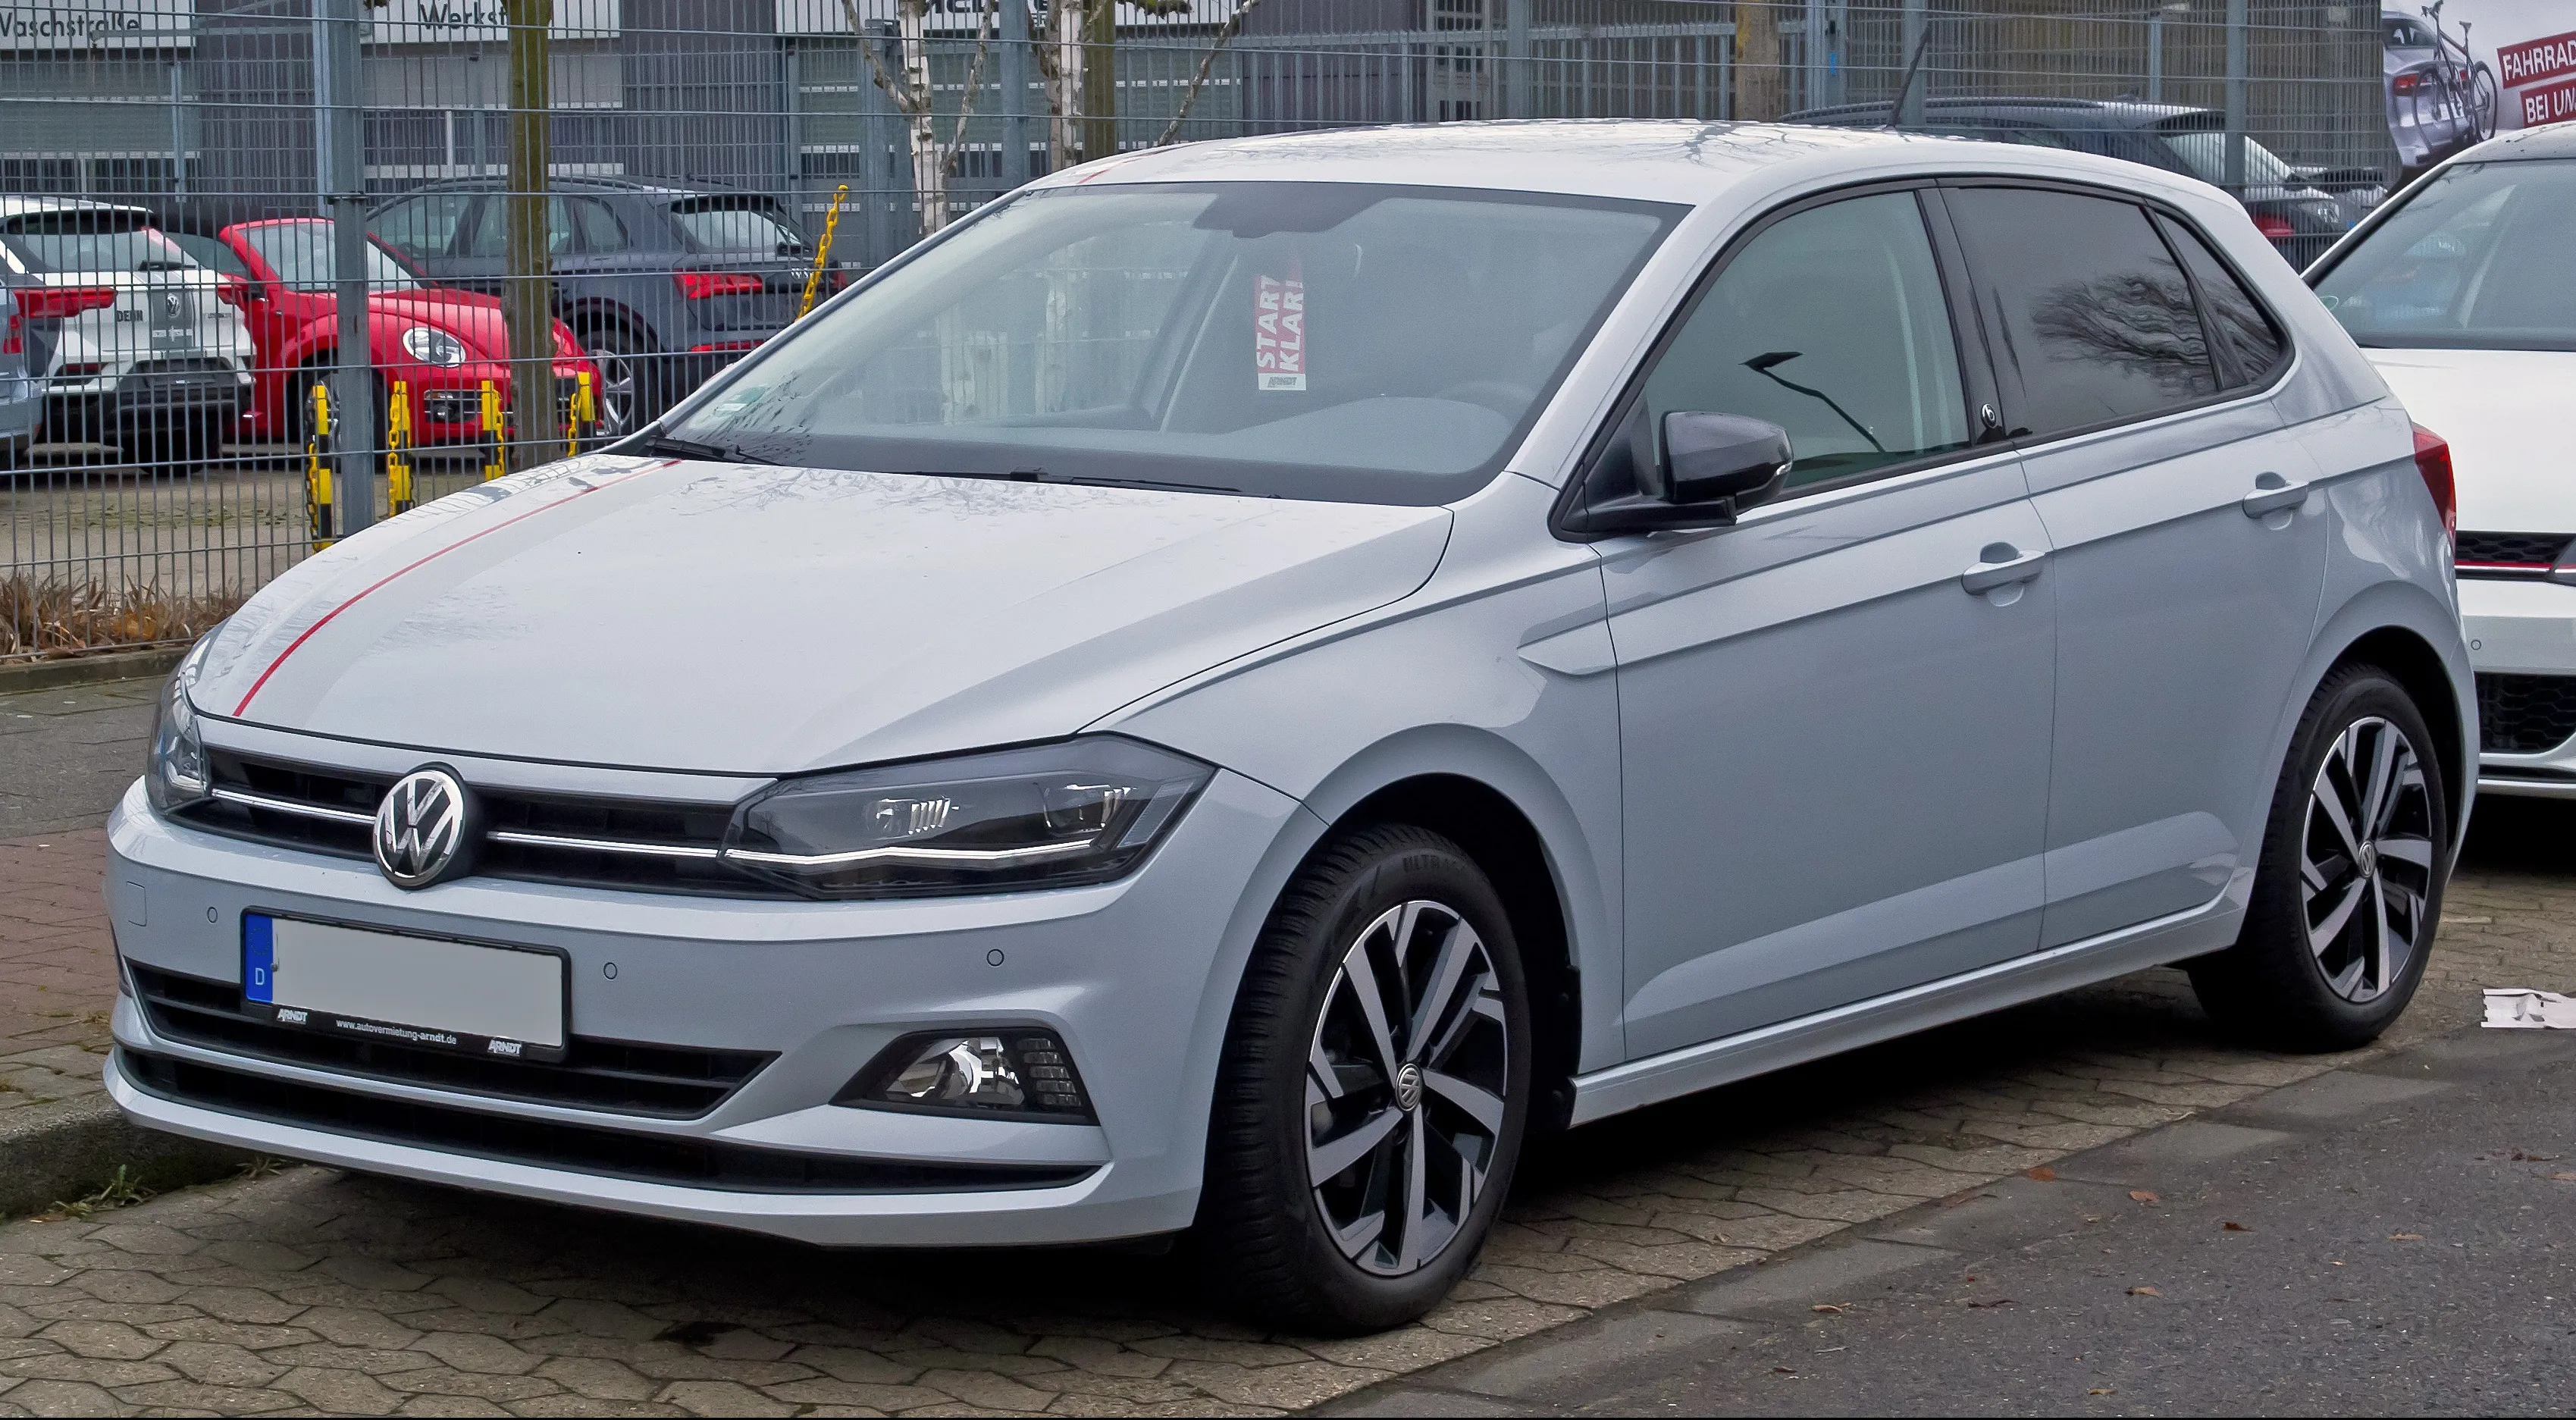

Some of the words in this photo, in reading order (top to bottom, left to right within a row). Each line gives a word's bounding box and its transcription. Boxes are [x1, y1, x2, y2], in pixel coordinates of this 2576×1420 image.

[420, 2, 507, 30] Werkst
[2525, 93, 2549, 124] BEI
[2553, 86, 2576, 117] UN
[1279, 280, 1304, 371] KLAR!
[255, 967, 265, 986] D
[276, 1008, 309, 1022] ARNDT
[336, 1019, 457, 1045] www.autovermietung-arndt.de
[487, 1039, 522, 1055] ARNDT
